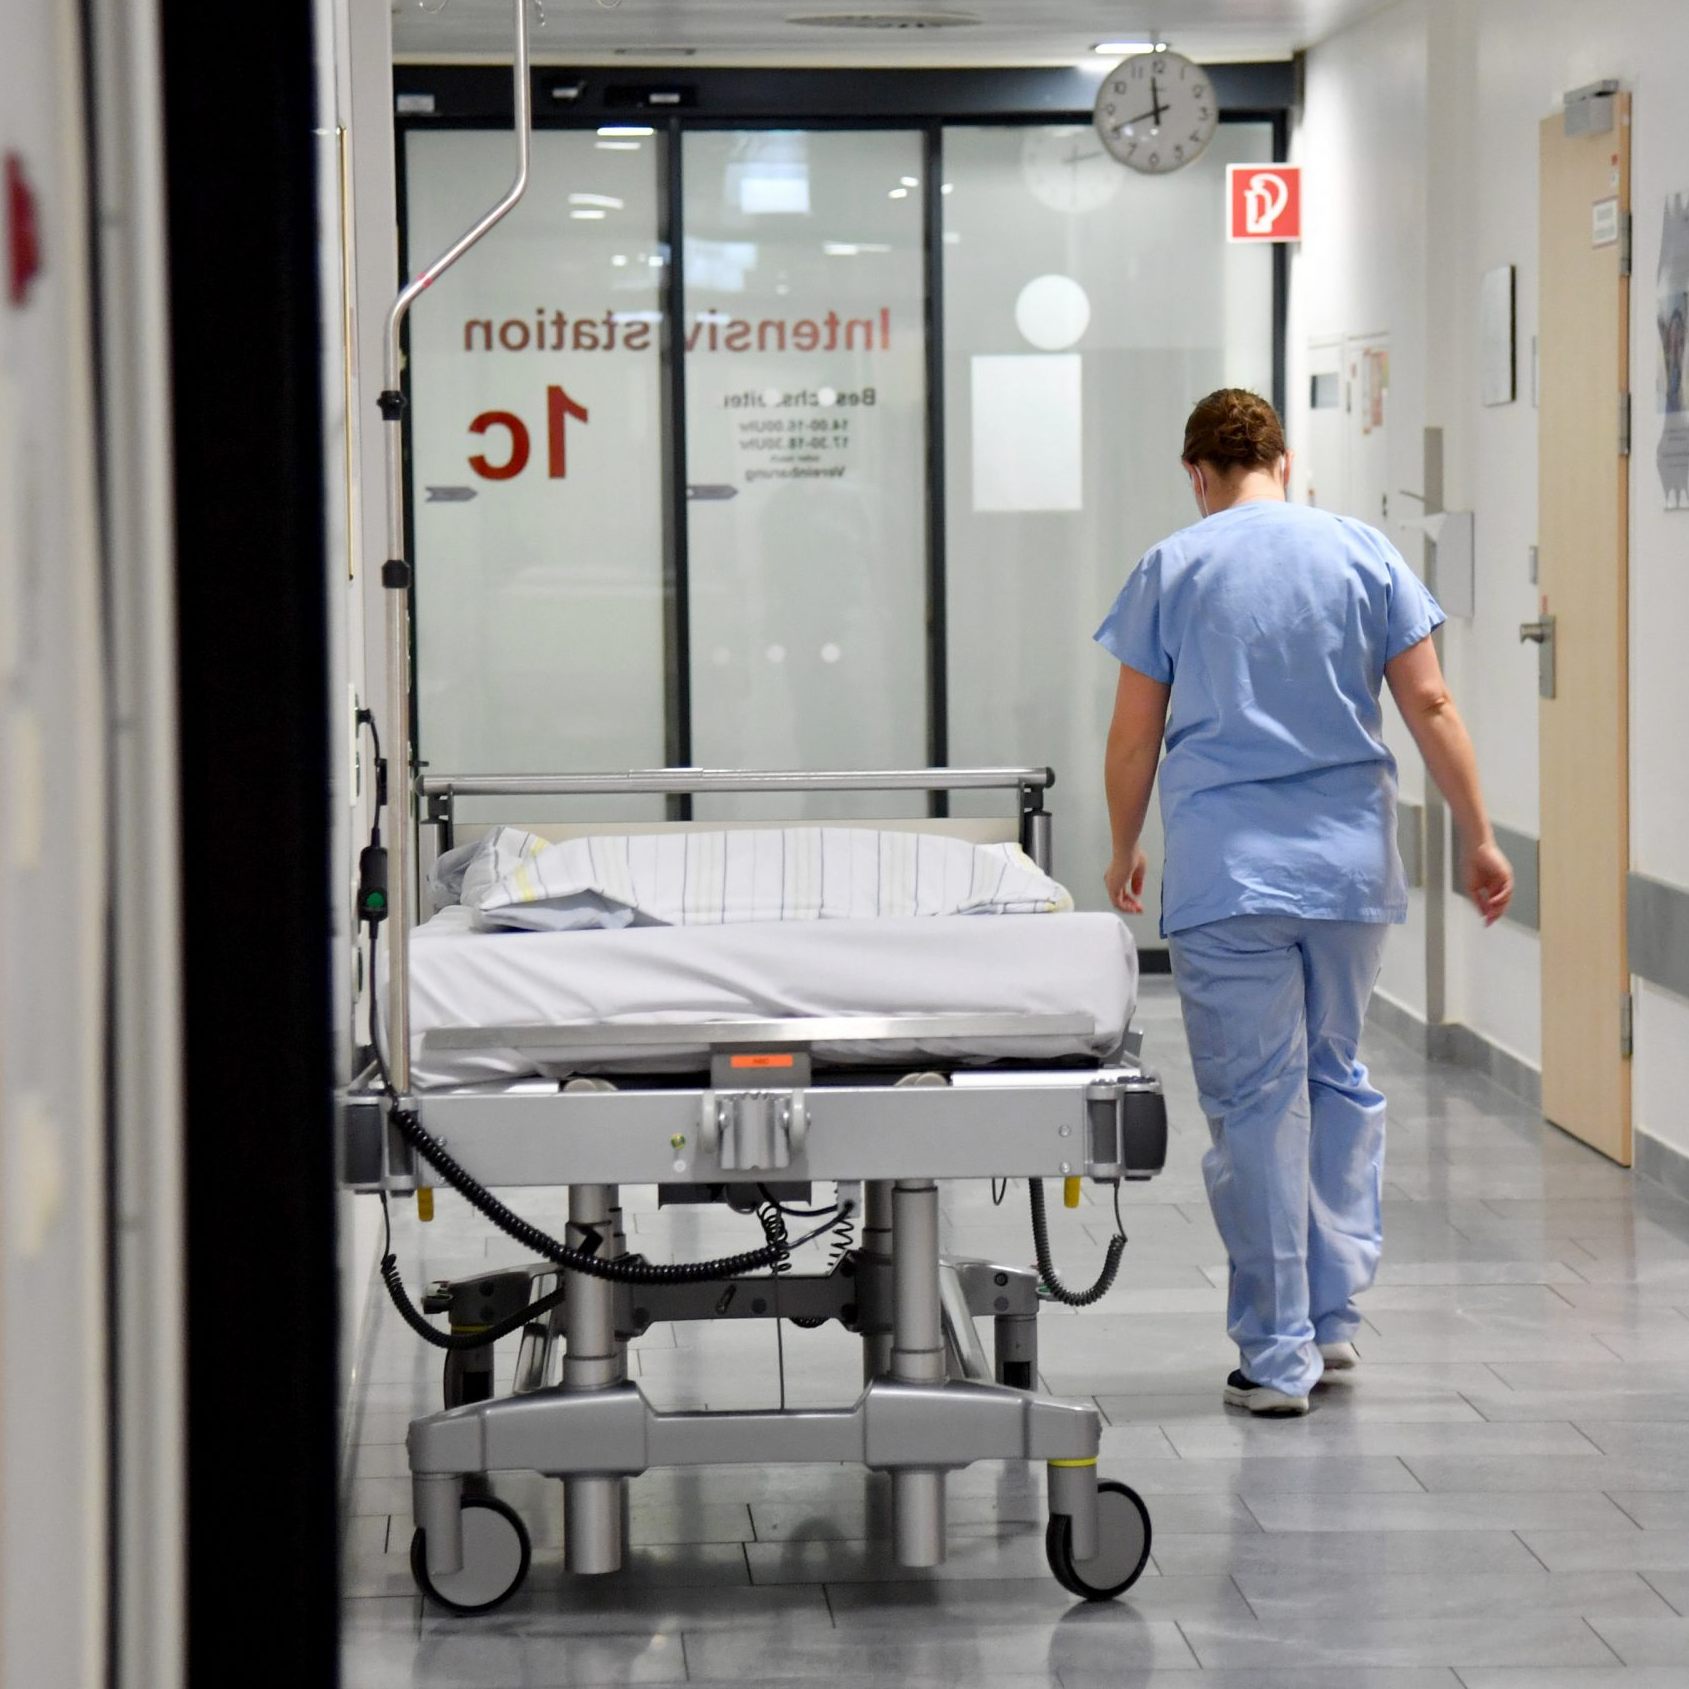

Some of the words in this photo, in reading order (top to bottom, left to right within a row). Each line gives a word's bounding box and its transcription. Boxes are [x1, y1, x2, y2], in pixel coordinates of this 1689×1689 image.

[1131, 66, 1143, 80] 11
[1153, 58, 1167, 74] 12
[1191, 83, 1204, 98] 2
